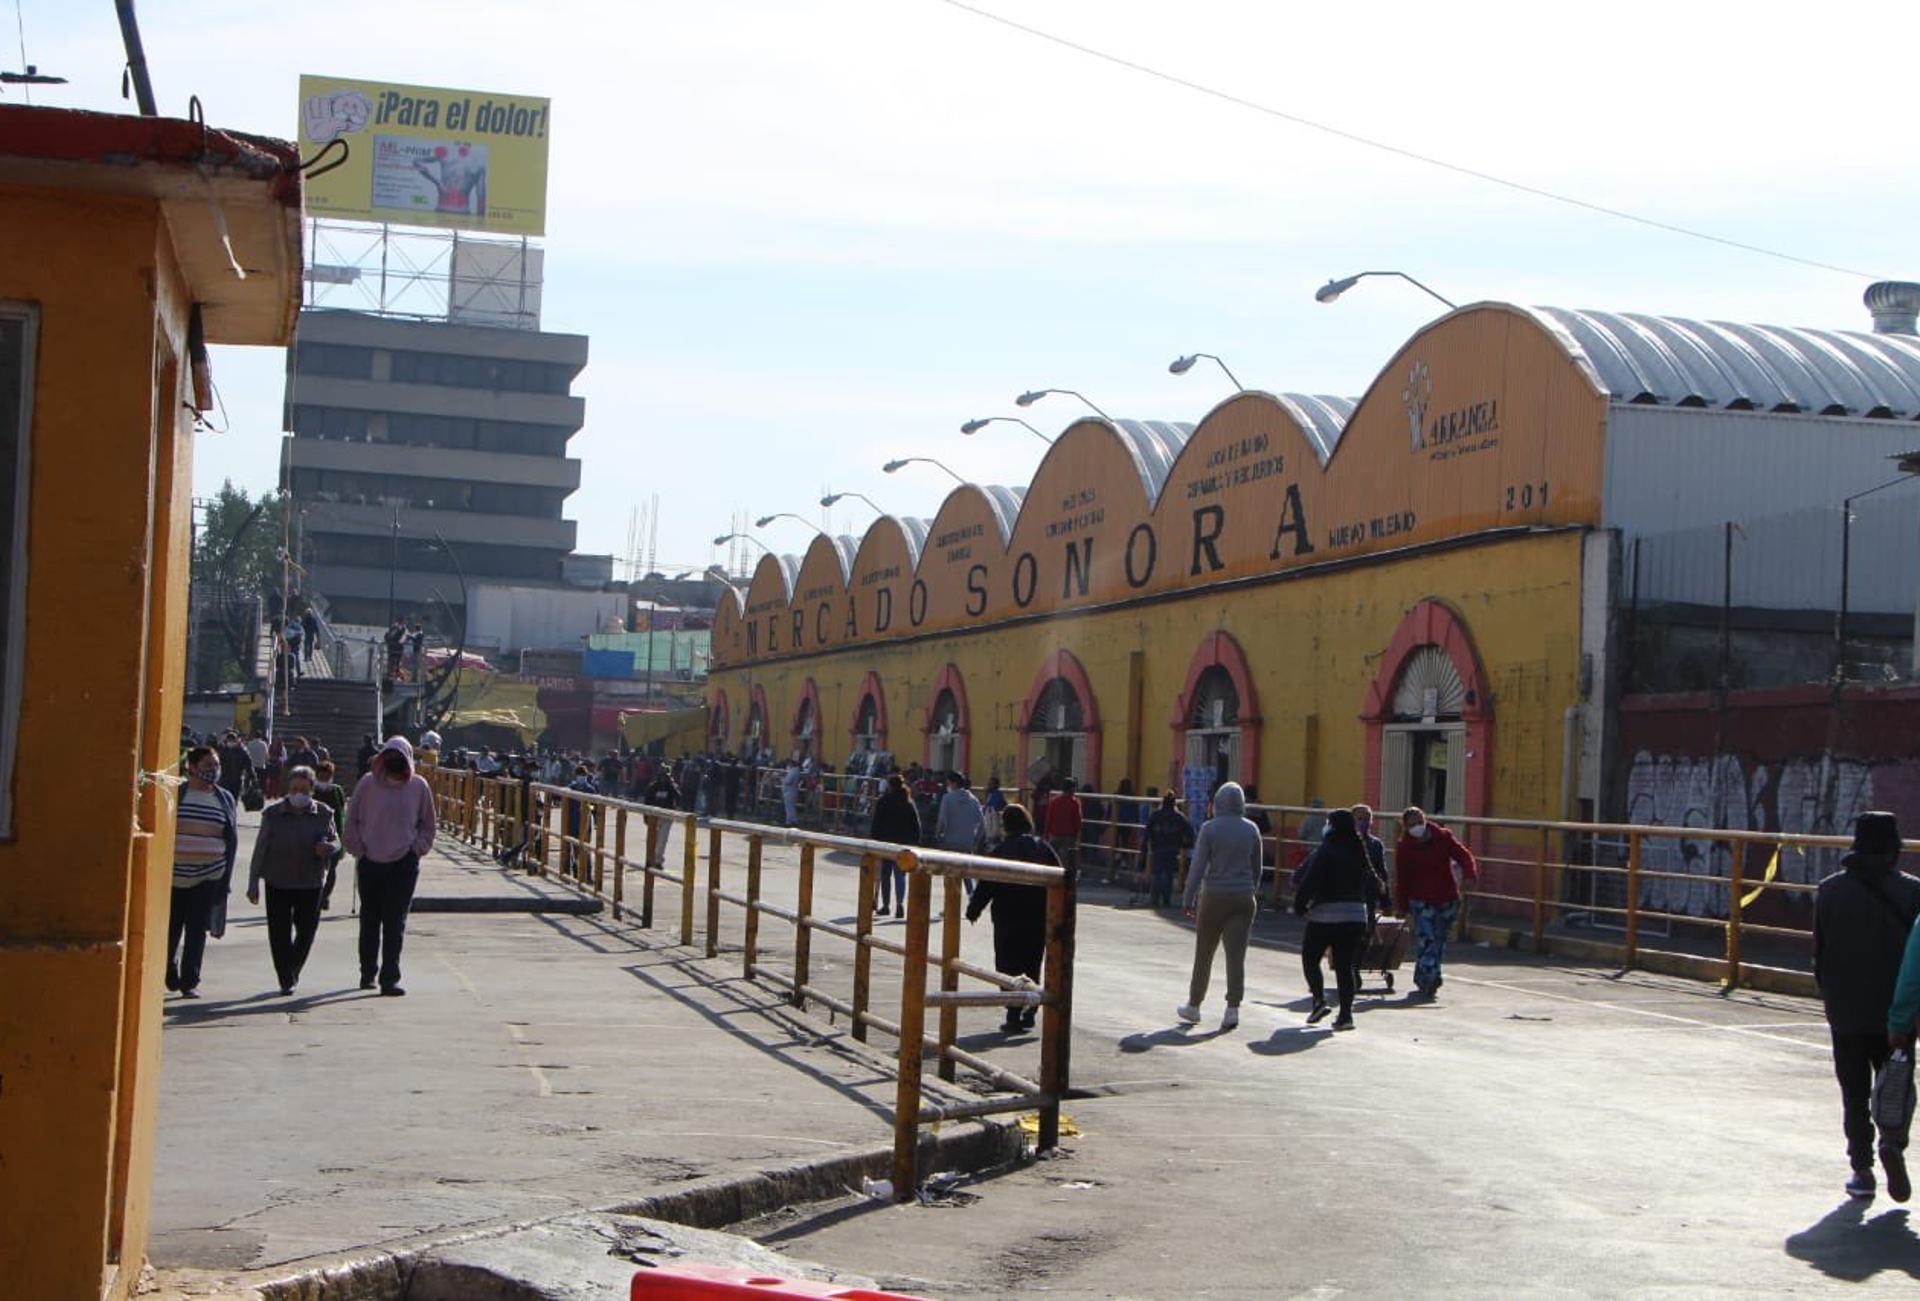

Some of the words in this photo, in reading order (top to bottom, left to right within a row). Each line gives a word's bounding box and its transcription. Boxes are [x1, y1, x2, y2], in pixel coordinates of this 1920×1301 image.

[375, 91, 440, 128] ¡Para
[445, 98, 471, 131] el
[475, 101, 548, 138] dolor!
[747, 579, 928, 657] MERCADO
[966, 483, 1315, 617] SONORA
